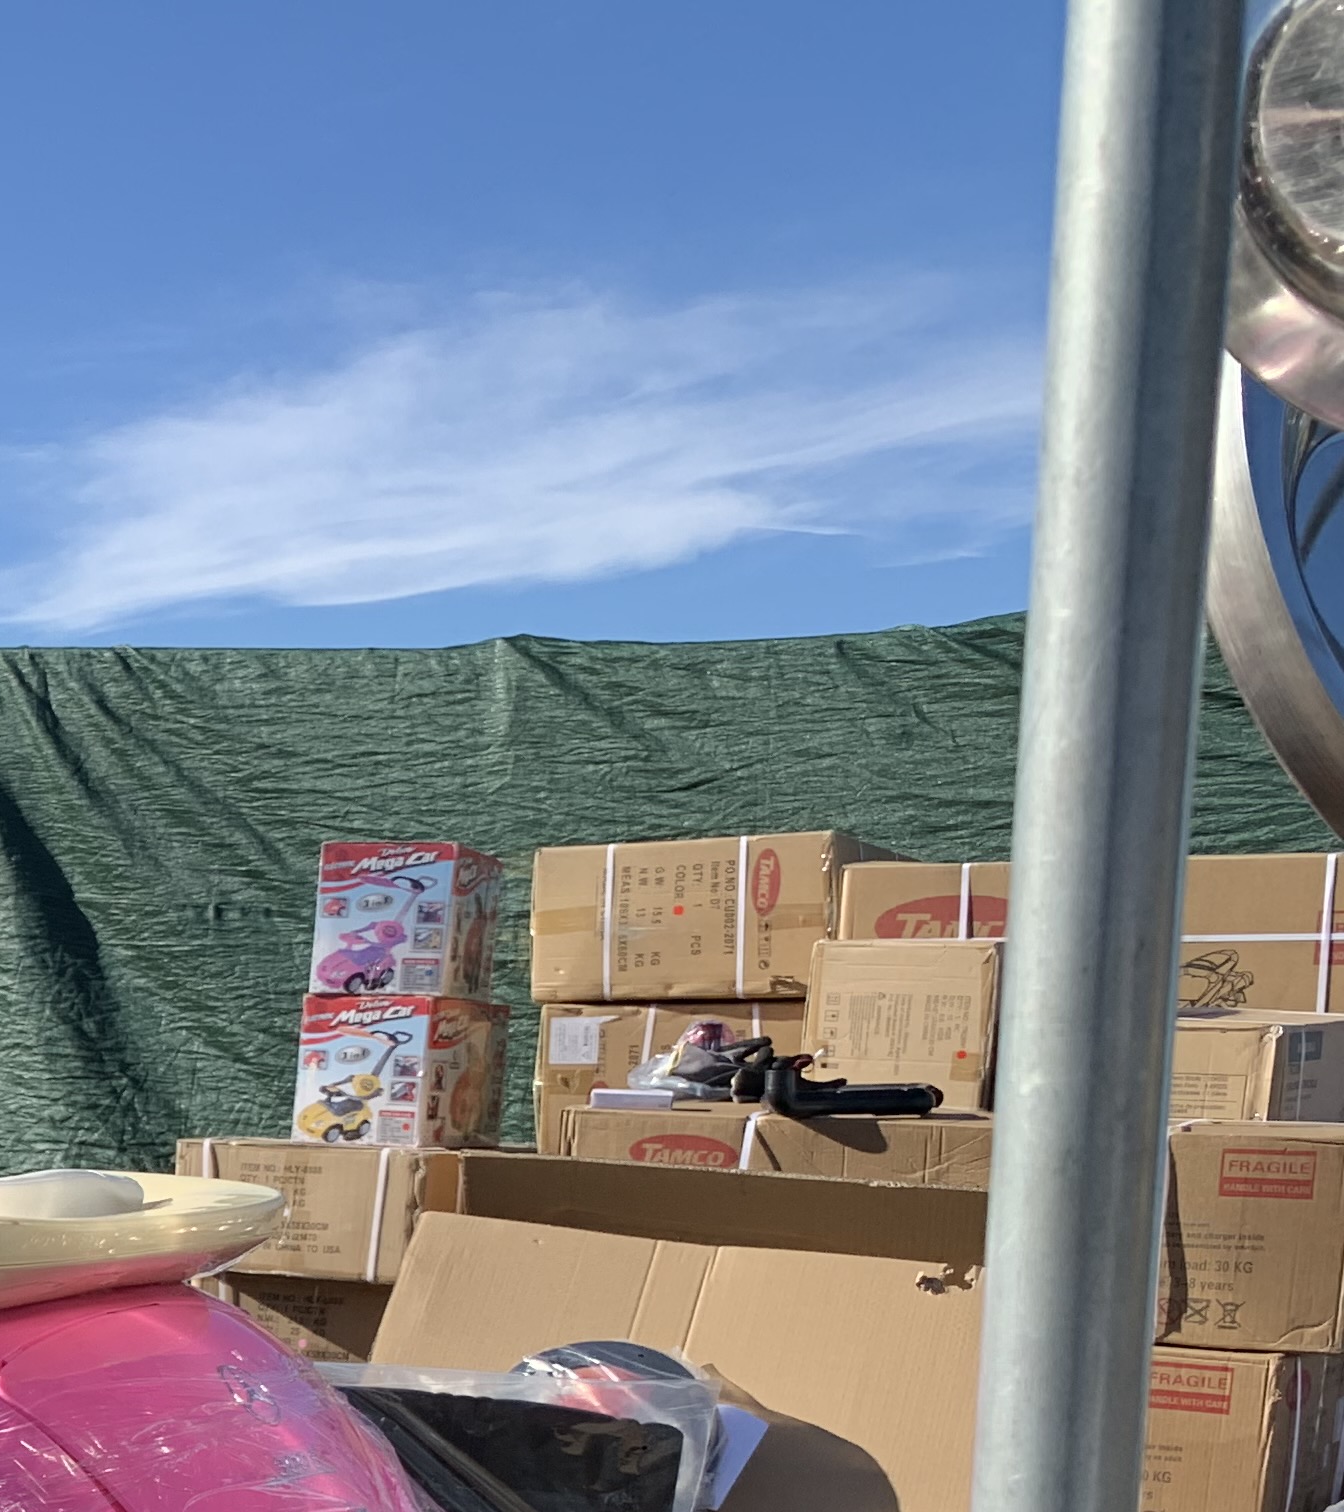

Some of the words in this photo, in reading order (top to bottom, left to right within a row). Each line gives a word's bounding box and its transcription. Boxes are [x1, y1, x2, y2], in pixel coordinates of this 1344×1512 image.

[350, 856, 404, 875] Mega
[404, 851, 440, 865] Car
[758, 855, 774, 908] TAMCO
[690, 935, 701, 957] PCS
[634, 953, 645, 969] KG
[650, 951, 661, 967] KG
[329, 1008, 380, 1028] Mega
[382, 1005, 416, 1019] Car
[641, 1143, 727, 1167] TAMCO
[1228, 1159, 1311, 1175] FRAGILE
[1223, 1183, 1260, 1193] HANDLE
[1262, 1184, 1286, 1194] WITH
[1286, 1185, 1311, 1195] CARE
[307, 1245, 318, 1253] TO
[323, 1245, 341, 1254] USA
[1214, 1260, 1230, 1273] 30
[1234, 1261, 1254, 1275] KG
[1200, 1280, 1234, 1295] years
[1181, 1397, 1204, 1407] WITH
[1152, 1471, 1172, 1484] KG
